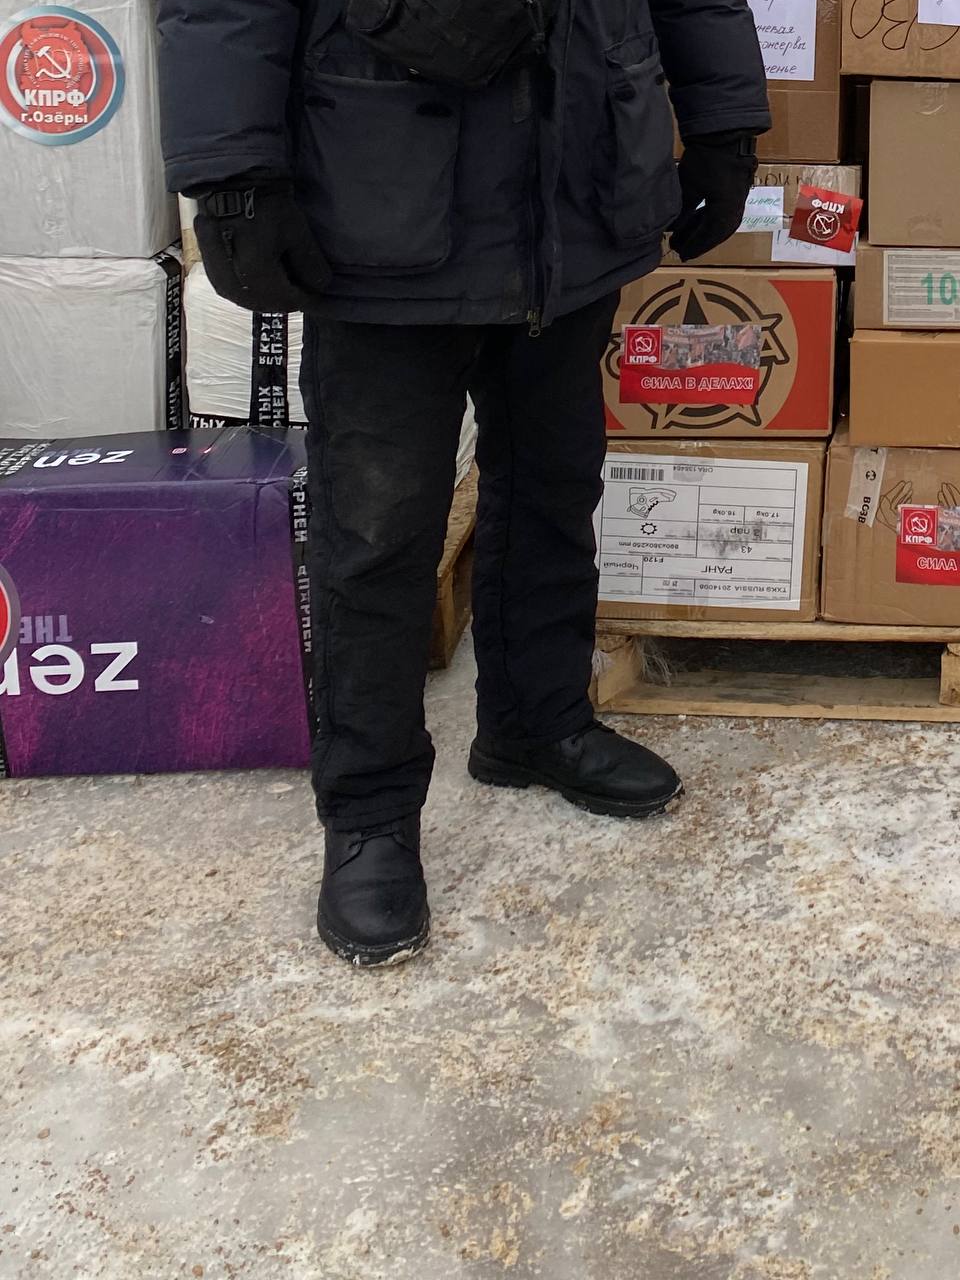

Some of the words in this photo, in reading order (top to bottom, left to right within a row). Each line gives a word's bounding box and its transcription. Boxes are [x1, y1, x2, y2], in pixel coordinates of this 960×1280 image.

[759, 36, 807, 56] онсервы
[24, 89, 86, 107] КПРФ
[20, 111, 88, 126] г.Озёры
[811, 198, 845, 214] КПРФ
[629, 355, 658, 364] КПРФ
[641, 376, 682, 389] СИЛА
[685, 377, 697, 389] В
[698, 376, 754, 391] ДЕЛАХ!
[32, 450, 134, 468] zen
[905, 534, 933, 544] КПРФ
[740, 546, 753, 554] 43
[701, 565, 733, 574] РАНГ
[916, 556, 957, 571] СИЛА
